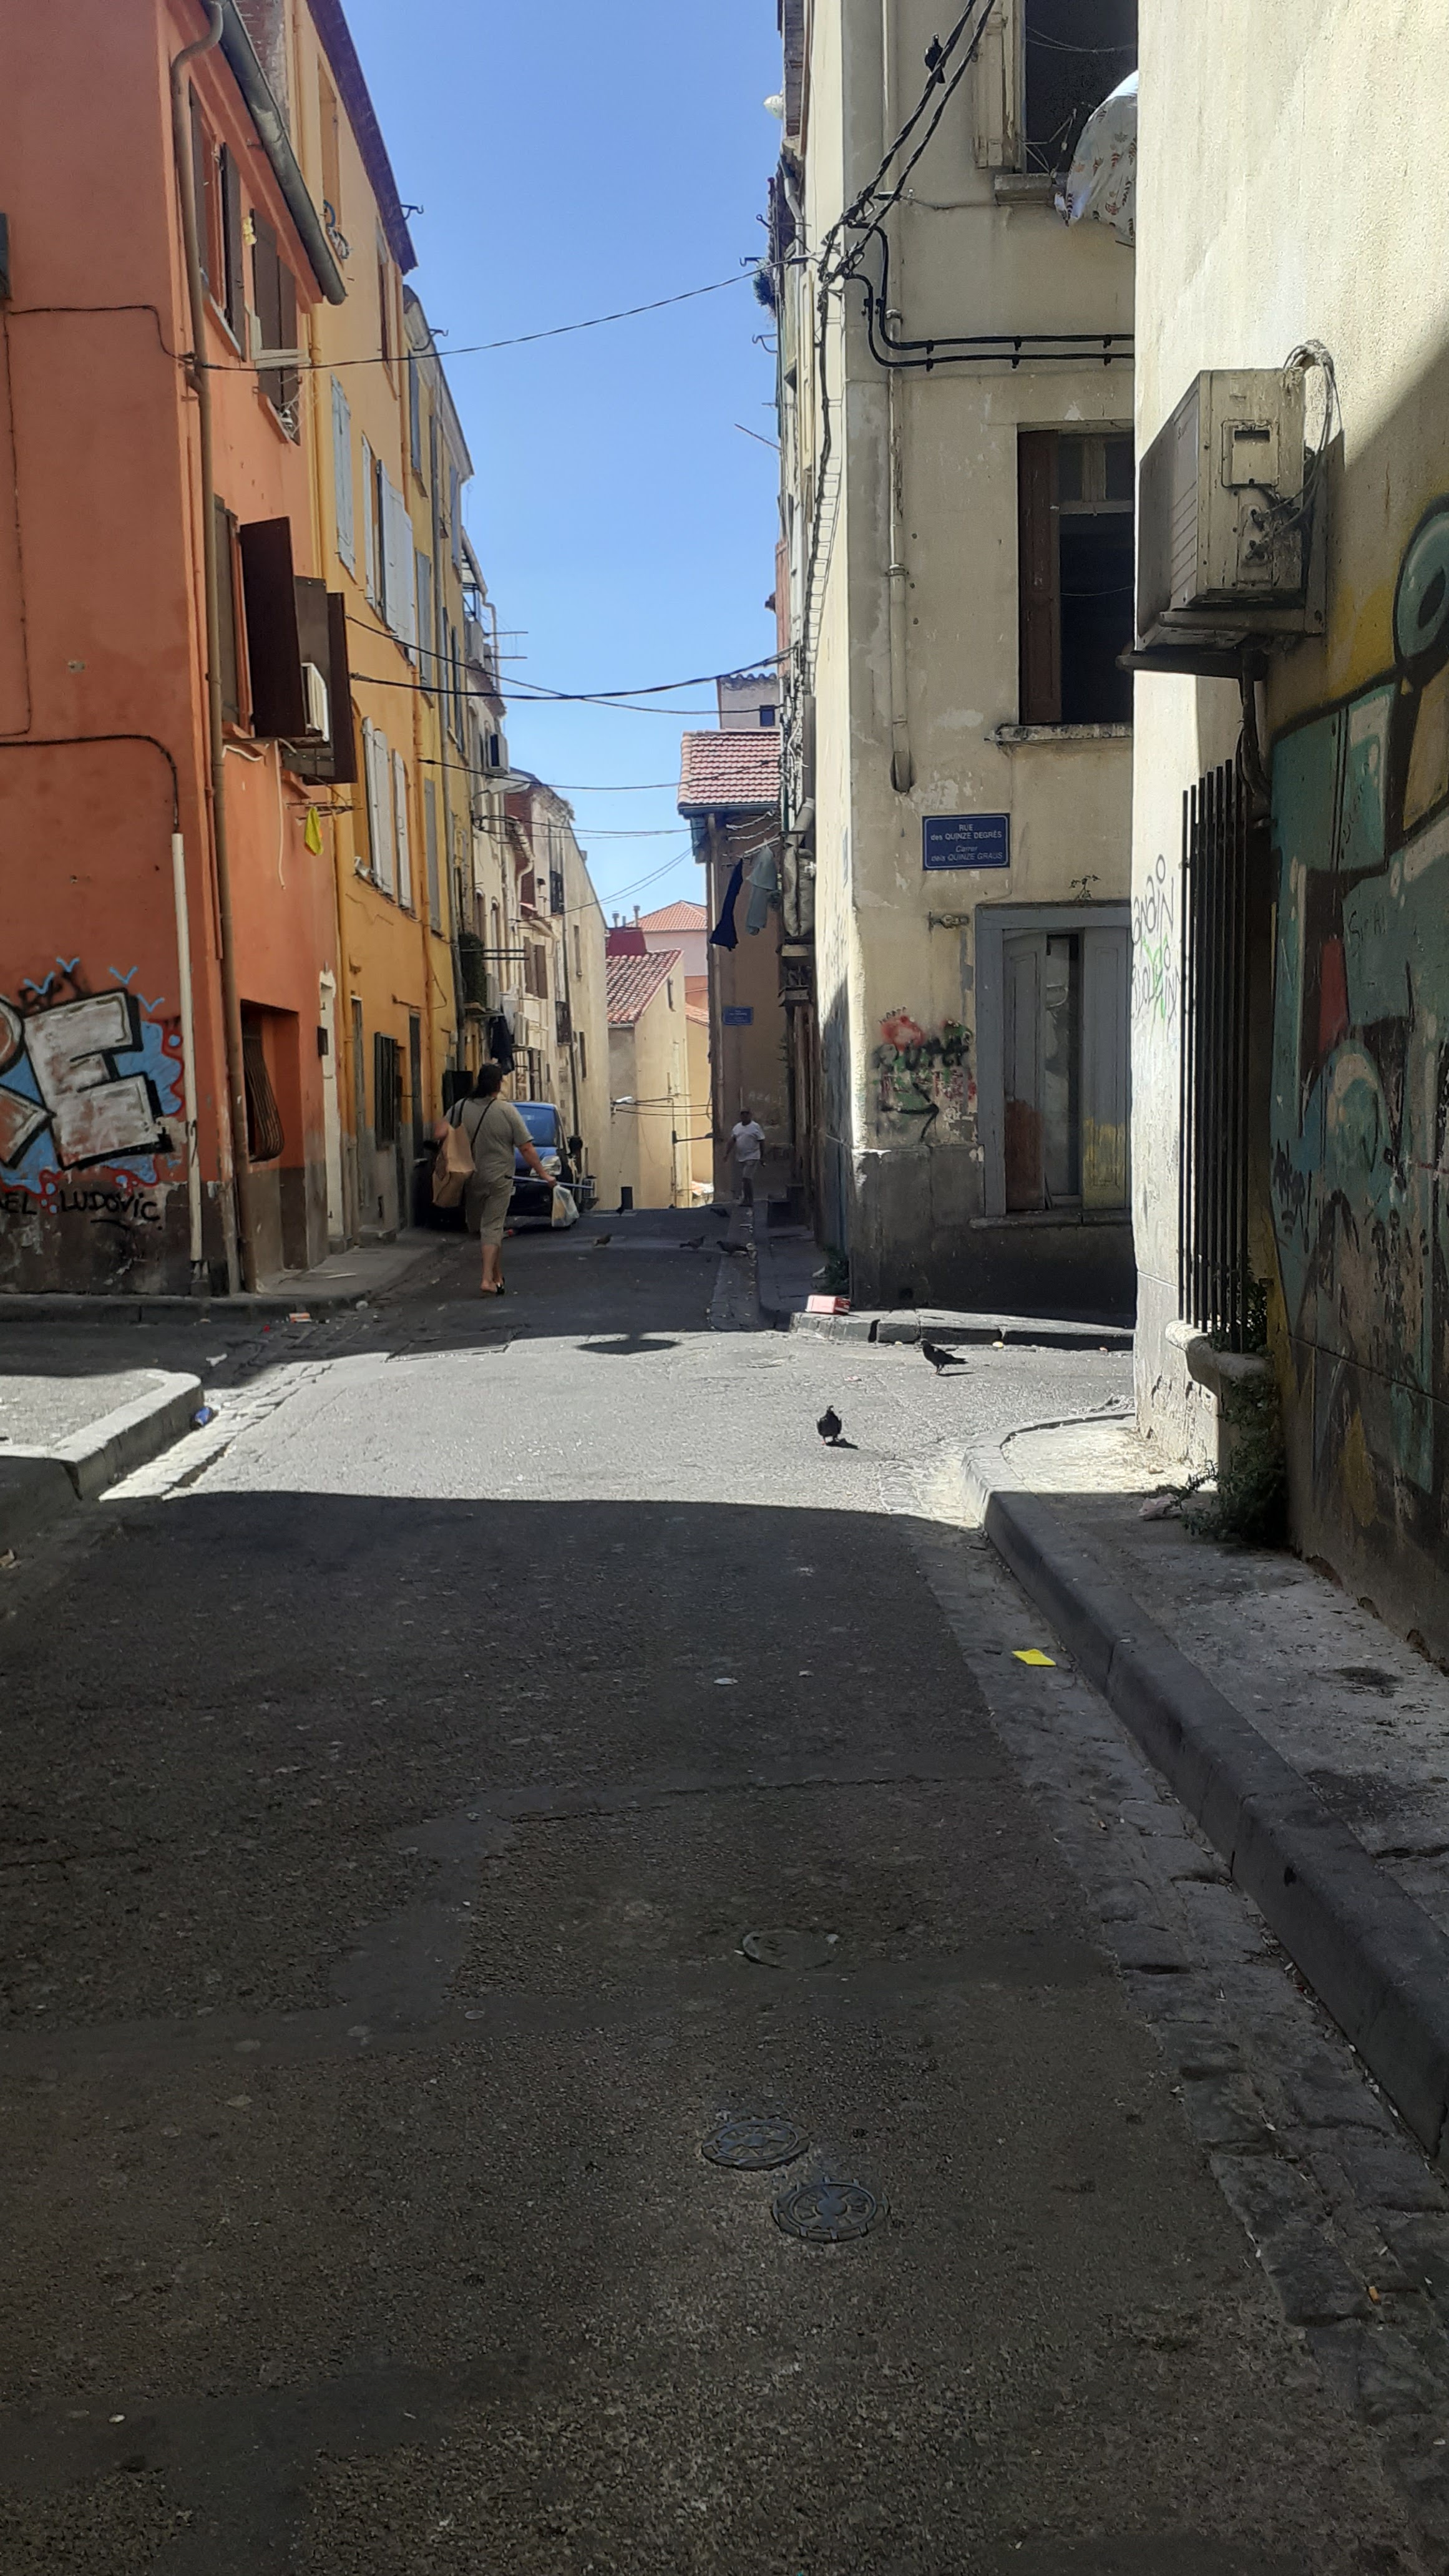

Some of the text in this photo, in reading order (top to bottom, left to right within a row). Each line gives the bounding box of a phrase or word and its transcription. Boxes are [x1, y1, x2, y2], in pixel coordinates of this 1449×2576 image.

[945, 831, 972, 841] QUINZE
[973, 830, 1002, 839] DEGRÉS
[947, 853, 975, 861] QUINZE
